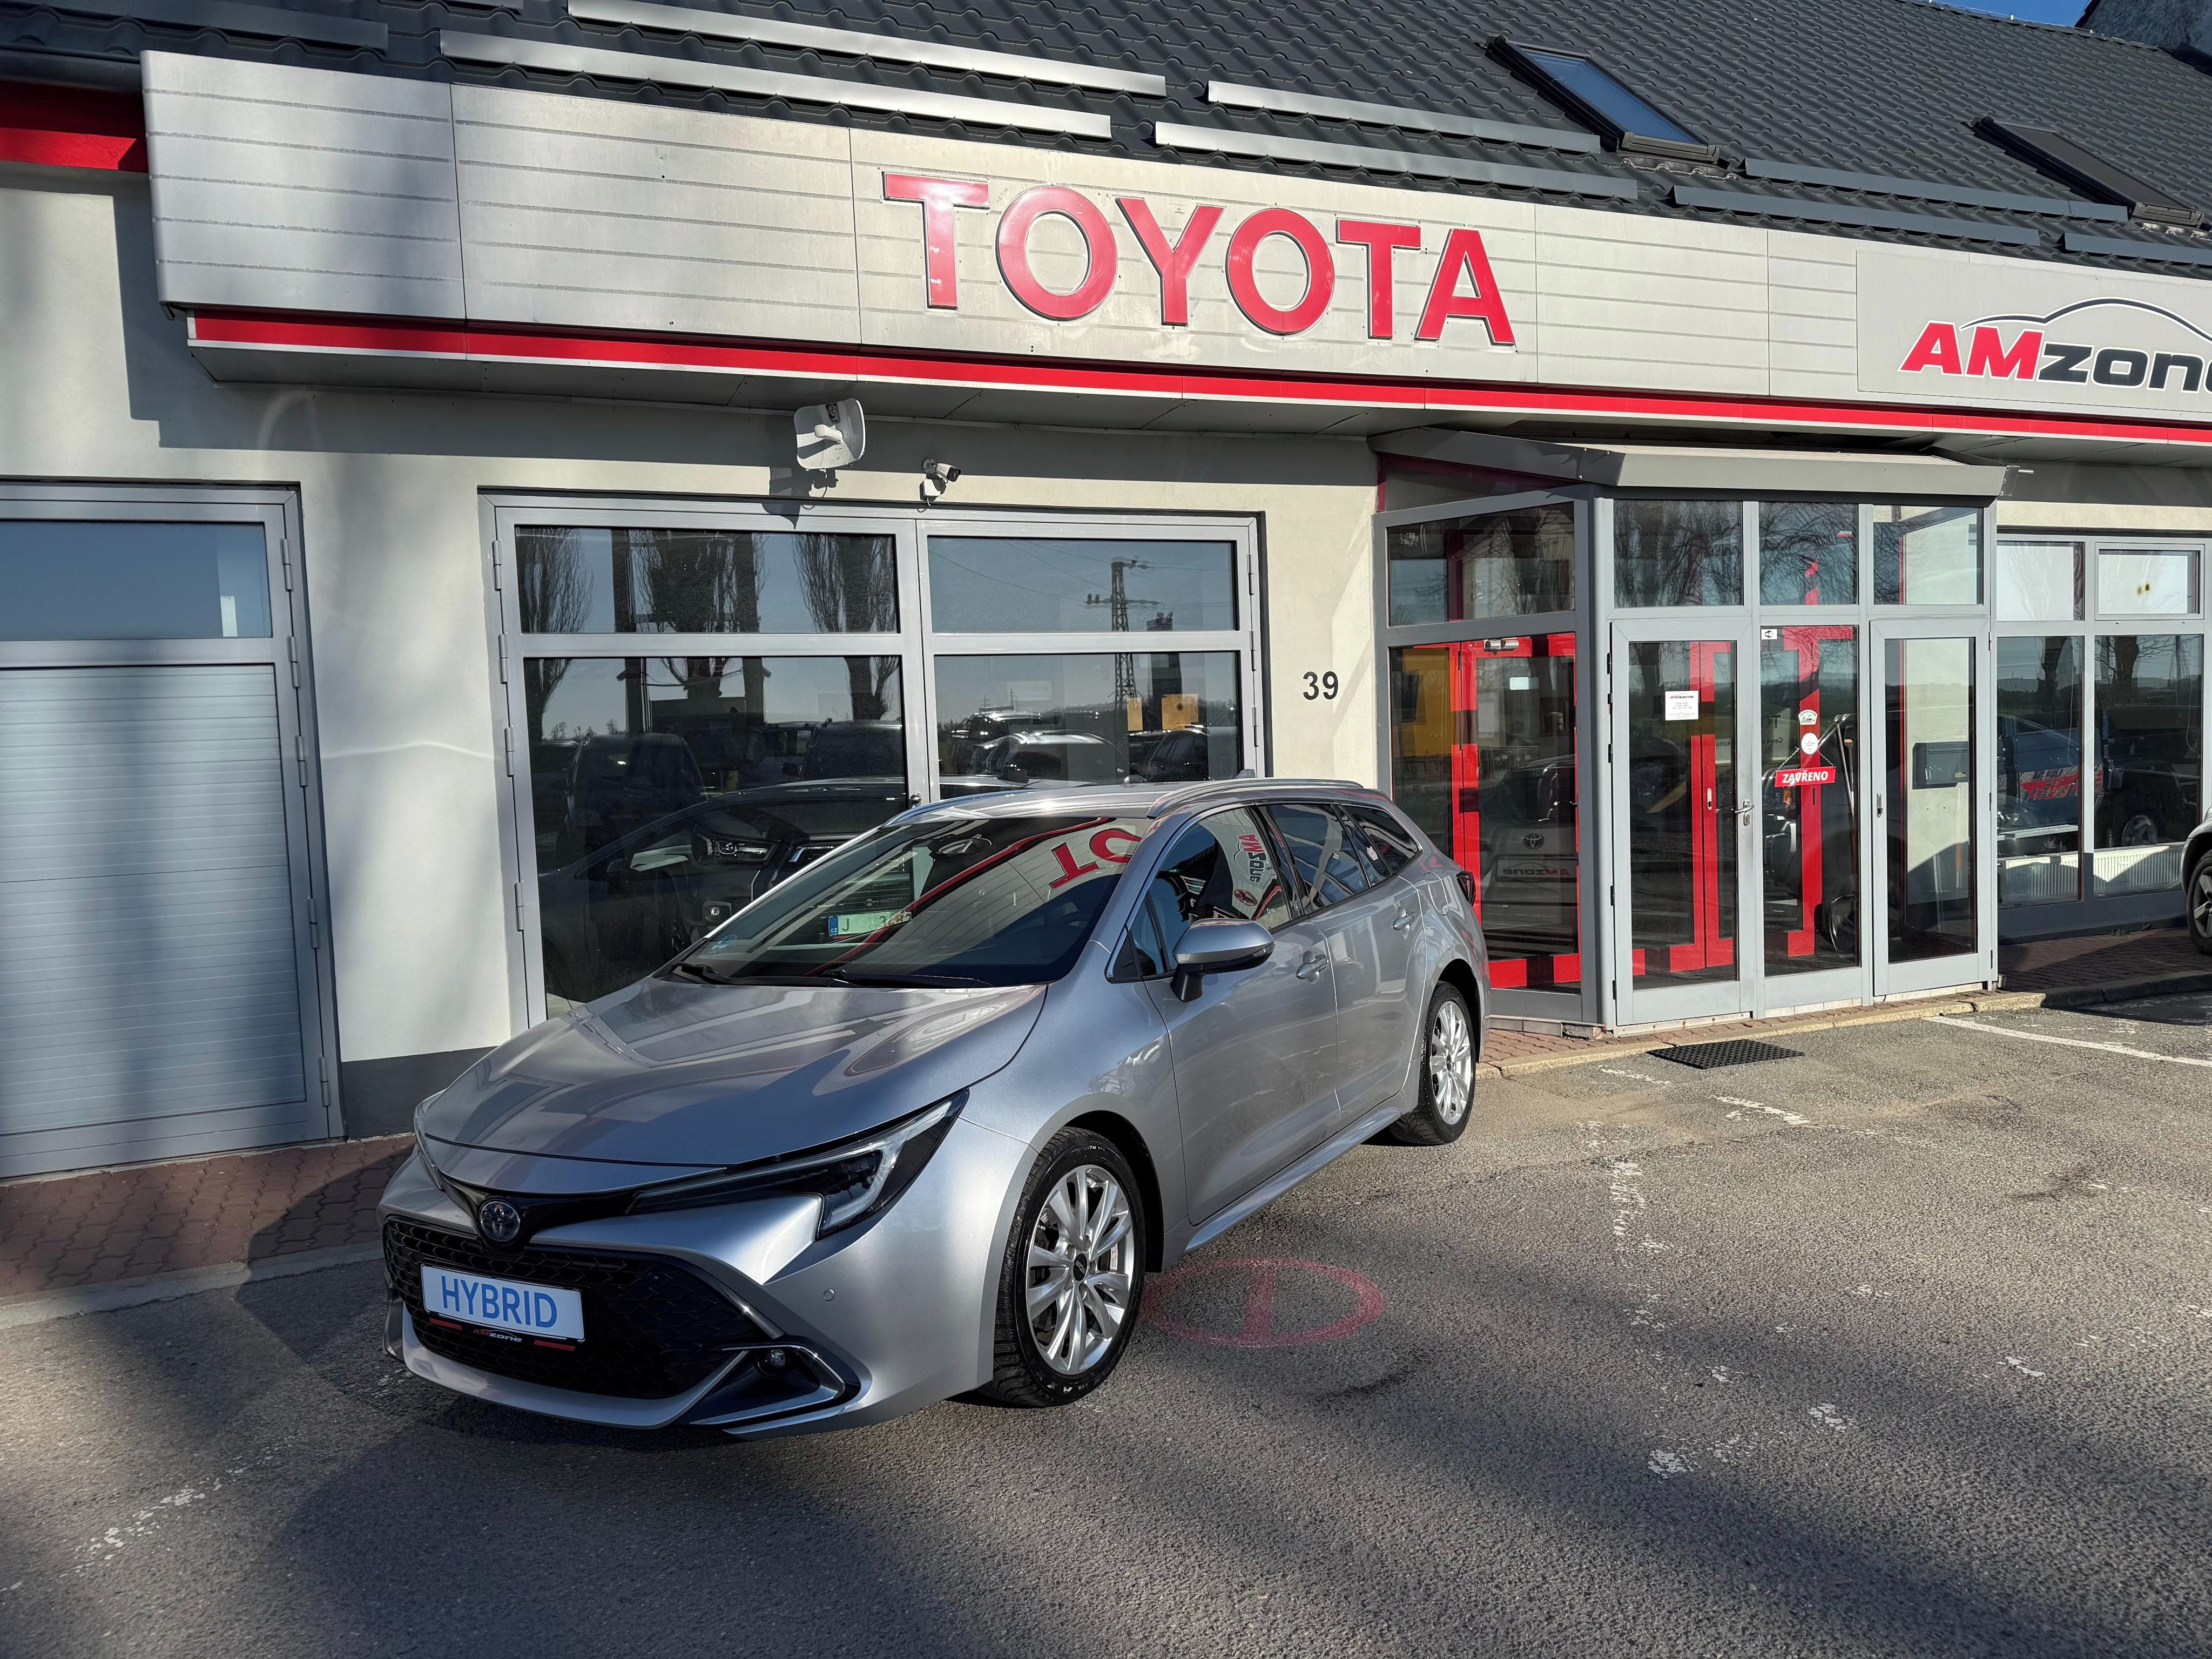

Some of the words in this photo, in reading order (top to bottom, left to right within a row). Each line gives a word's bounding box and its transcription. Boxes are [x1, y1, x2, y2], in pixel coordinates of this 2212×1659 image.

[883, 171, 1516, 346] TOYOTA
[1897, 320, 2212, 394] AMzon
[1303, 671, 1339, 700] 39
[1782, 769, 1829, 784] ZAVŘENO
[441, 1275, 558, 1328] HYBRID
[473, 1328, 523, 1343] AMzone
